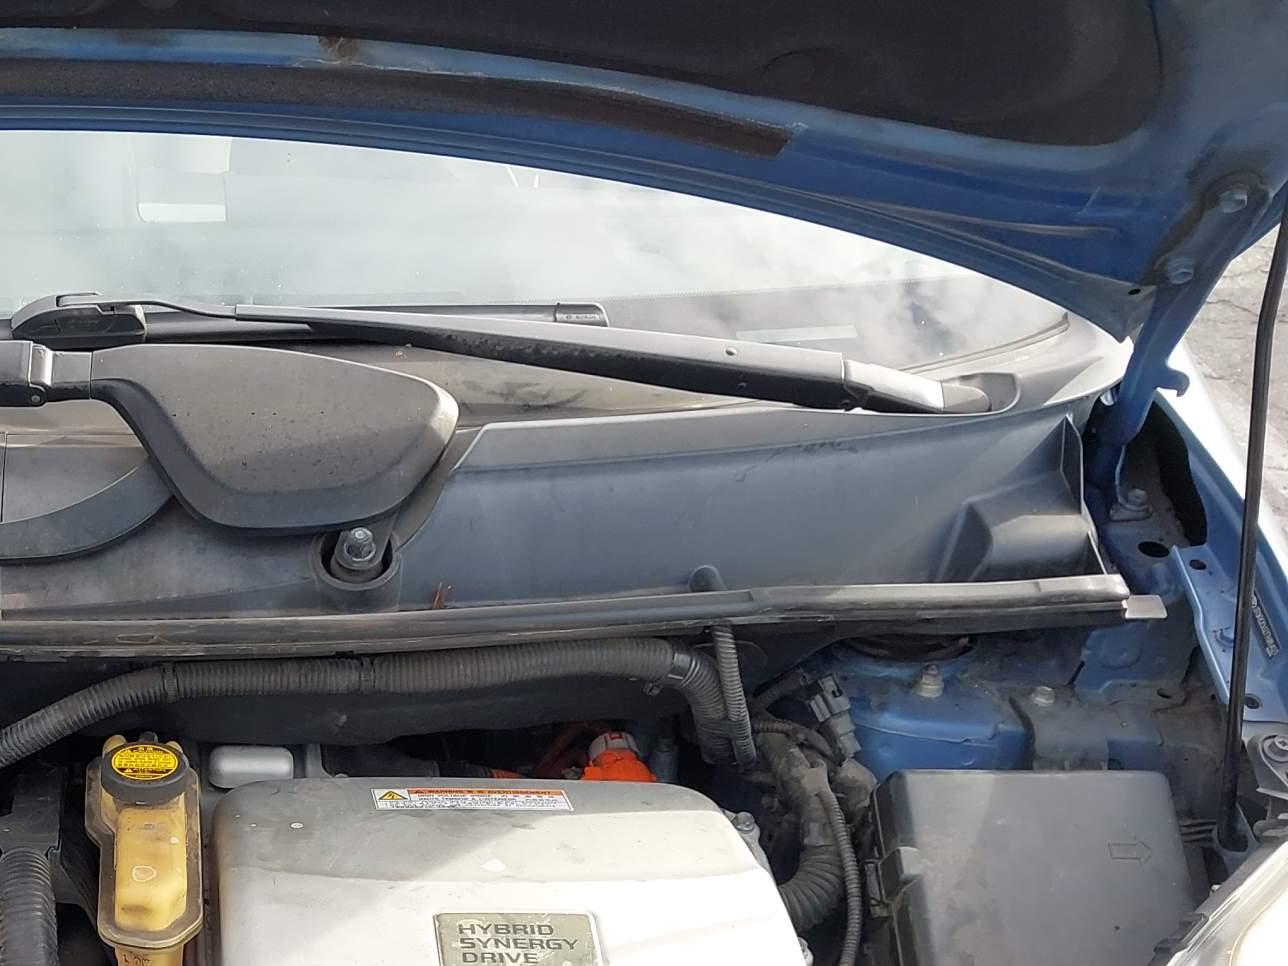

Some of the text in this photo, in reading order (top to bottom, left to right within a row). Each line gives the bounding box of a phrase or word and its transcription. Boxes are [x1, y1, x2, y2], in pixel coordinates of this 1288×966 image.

[458, 923, 554, 936] HYBRID
[459, 937, 579, 950] SYNERGY
[463, 952, 540, 964] DRIVE
